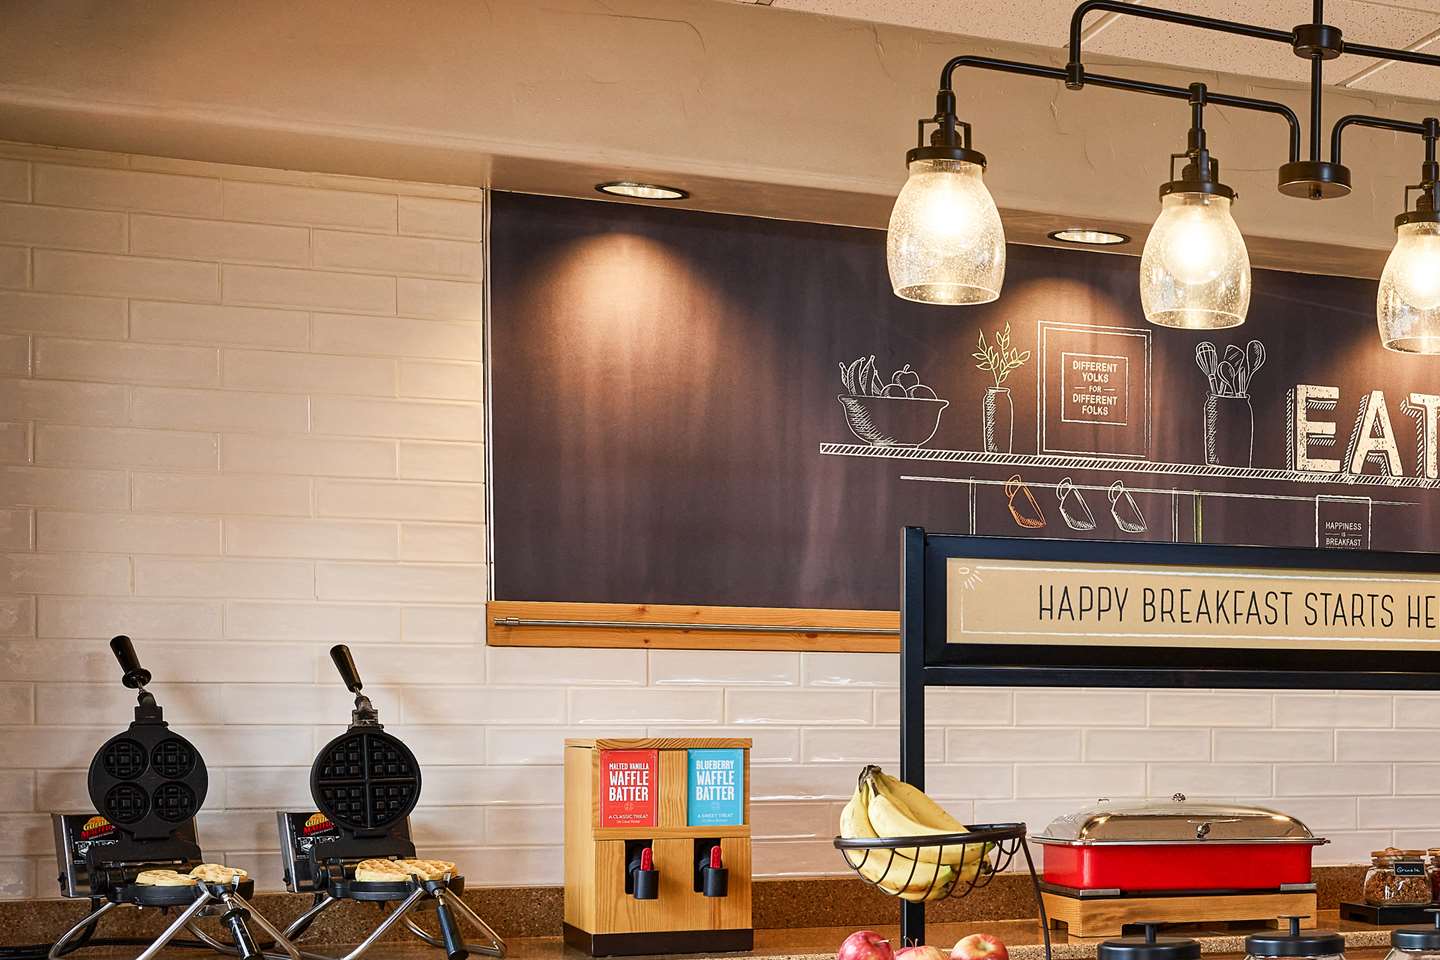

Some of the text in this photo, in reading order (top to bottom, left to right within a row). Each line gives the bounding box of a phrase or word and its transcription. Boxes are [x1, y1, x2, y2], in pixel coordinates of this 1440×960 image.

[1072, 360, 1118, 373] DIFFERENT
[1082, 372, 1109, 383] YOLKS
[1088, 385, 1102, 393] FOR
[1072, 393, 1118, 406] DIFFERENT
[1081, 405, 1109, 416] FOLKS
[1325, 521, 1362, 531] HAPPINESS
[1325, 538, 1361, 547] BREAKFAST
[1039, 584, 1129, 622] HAPPY
[1143, 587, 1293, 625] BREAKFAST
[1304, 592, 1394, 628] STARTS
[608, 762, 649, 770] MALTED VANILLA
[695, 759, 735, 770] BLUEBERRY
[609, 770, 649, 786] WAFFLE
[696, 770, 736, 786] WAFFLE
[609, 786, 649, 802] BATTER
[695, 786, 735, 801] BATTER
